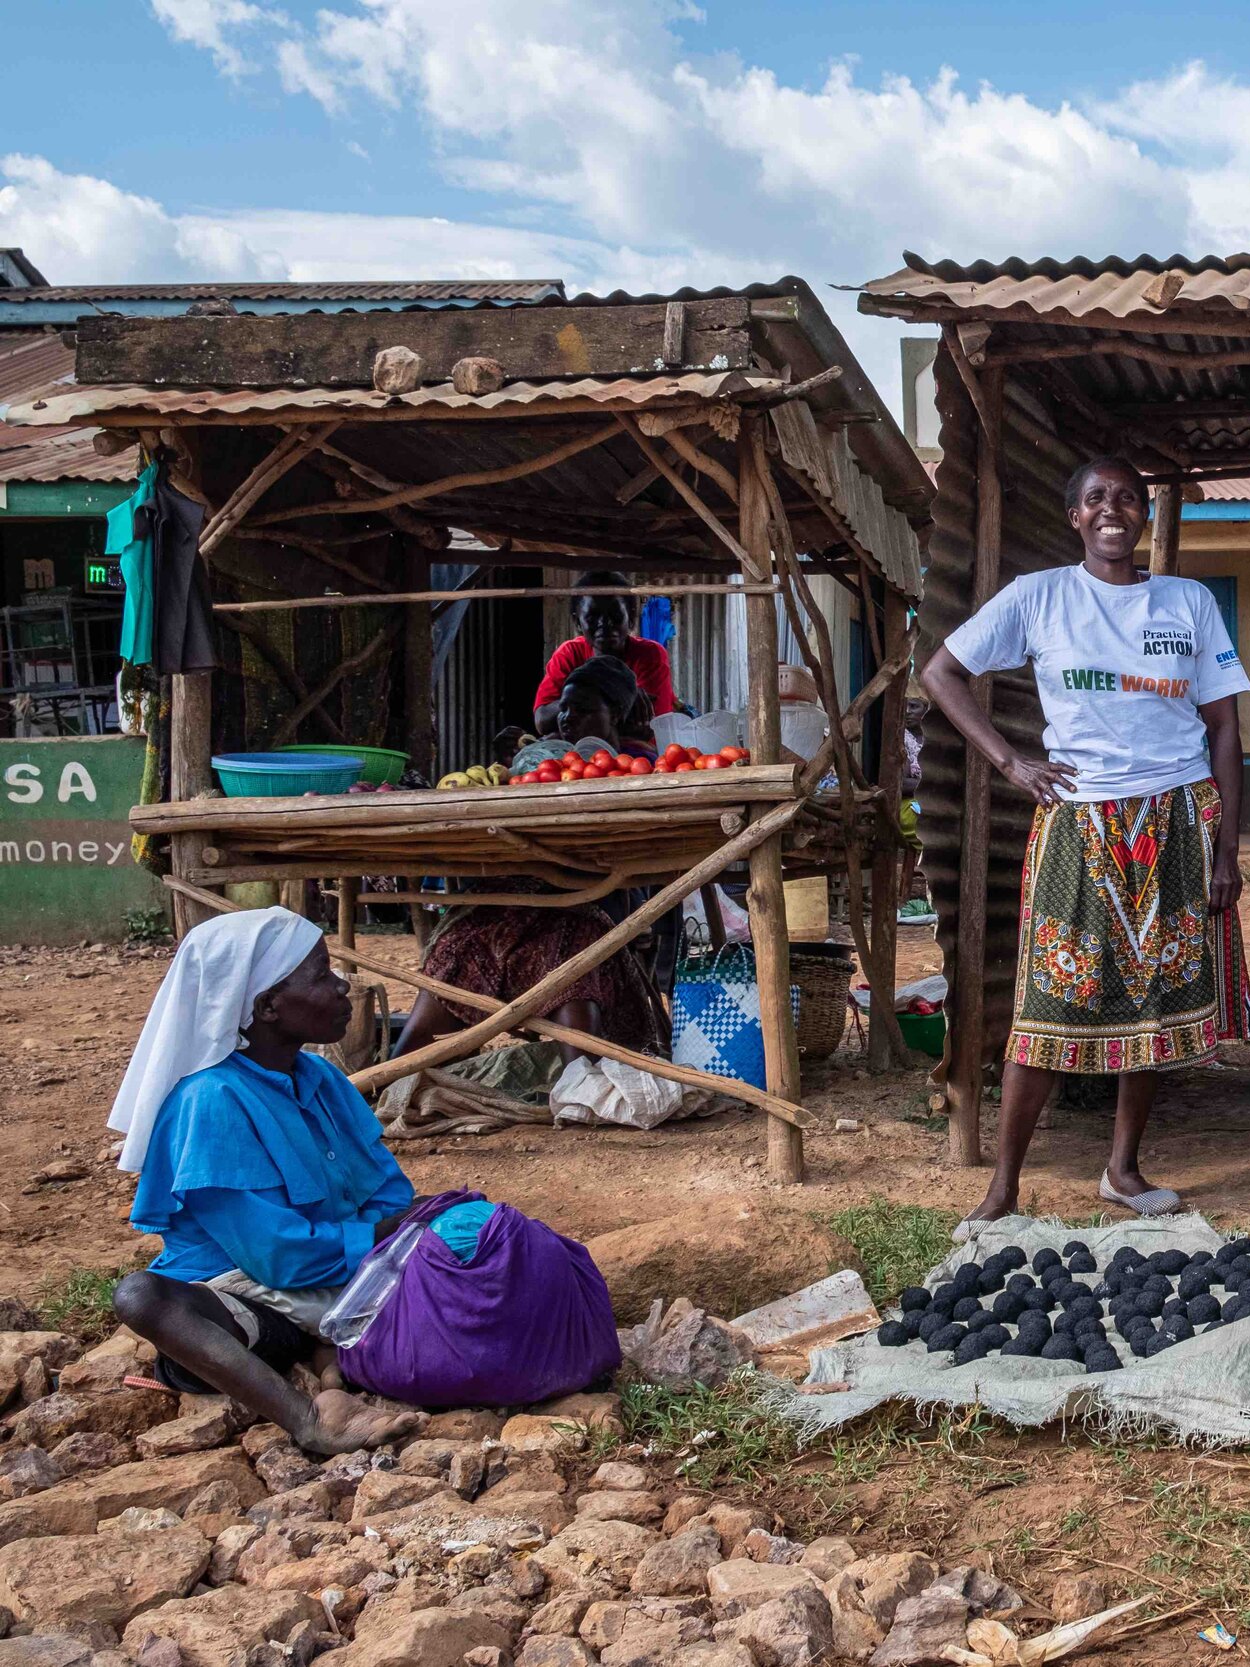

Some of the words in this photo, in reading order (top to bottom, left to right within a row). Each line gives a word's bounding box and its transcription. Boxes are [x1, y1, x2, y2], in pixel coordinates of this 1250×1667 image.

[1142, 629, 1192, 640] Practical
[1143, 640, 1193, 657] ACTION
[1062, 669, 1116, 692] EWEE
[1120, 673, 1190, 699] WORKS
[0, 839, 125, 866] money
